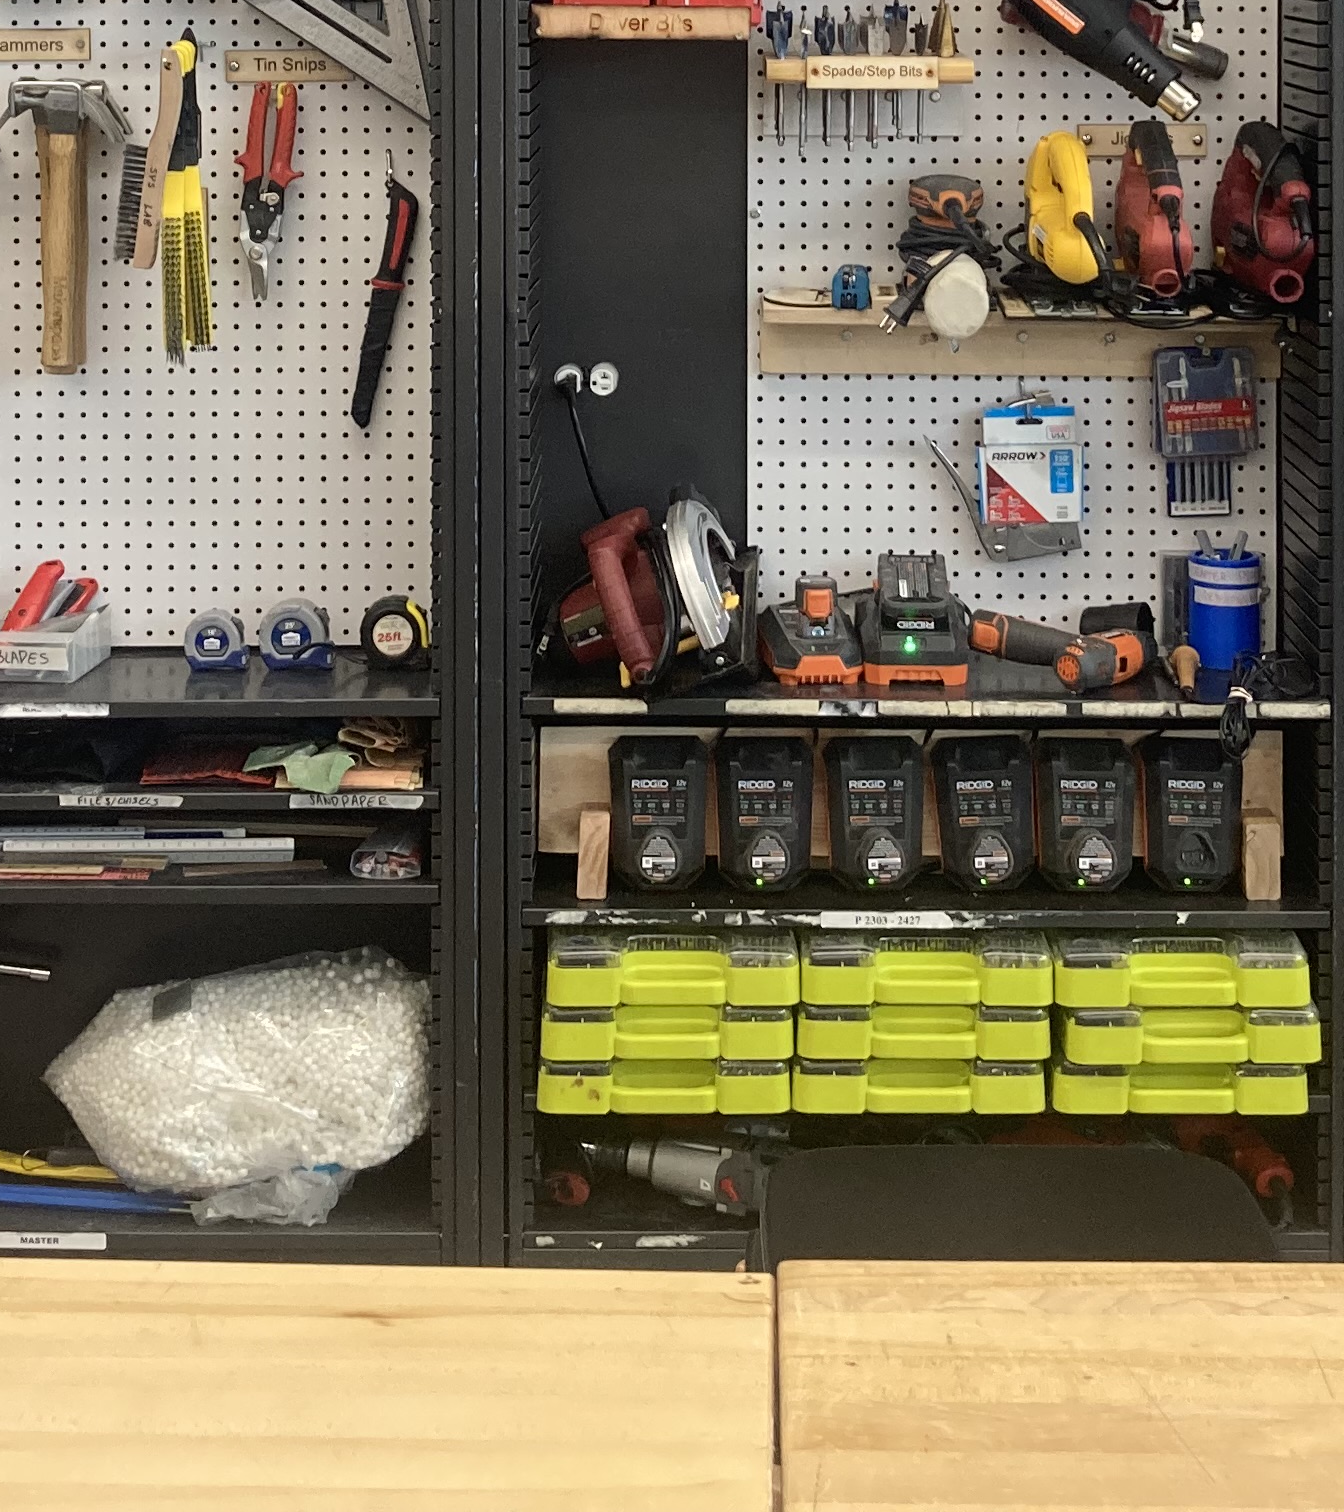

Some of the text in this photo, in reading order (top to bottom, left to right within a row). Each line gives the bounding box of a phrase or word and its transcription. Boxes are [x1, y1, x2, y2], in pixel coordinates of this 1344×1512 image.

[590, 12, 649, 32] Dver
[254, 56, 327, 74] Tin Snips
[822, 65, 923, 78] Spade/Step Bits
[1167, 402, 1222, 415] Jigsaw Blades
[992, 452, 1038, 461] ARROW
[377, 632, 402, 643] 25ft
[631, 779, 669, 789] RIDGID
[737, 780, 775, 790] RIDGID
[848, 780, 886, 789] RIDGID
[956, 780, 994, 790] RIDGID
[1060, 779, 1098, 789] RIDGID
[1167, 779, 1206, 789] RIDGID
[309, 794, 387, 807] SANDPAPER
[856, 916, 862, 925] P
[865, 916, 888, 925] 2303
[898, 916, 921, 925] 2427
[20, 1237, 59, 1245] MASTER
